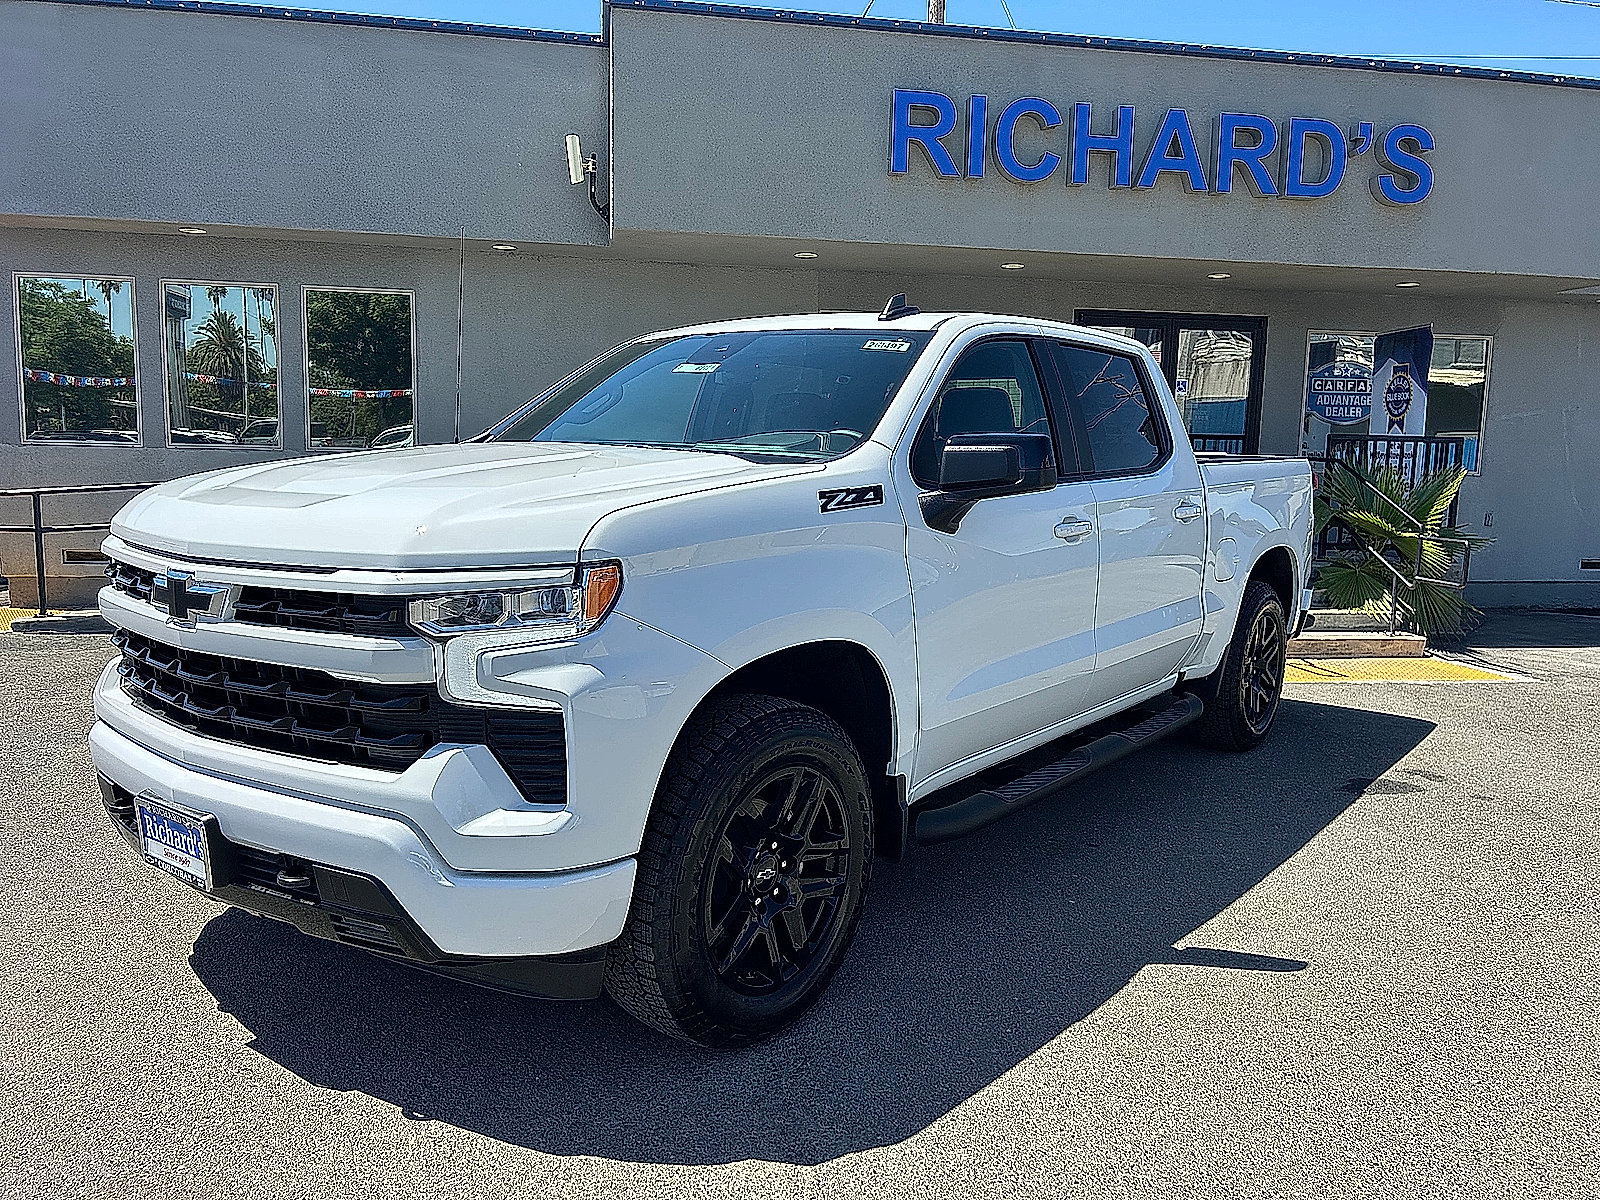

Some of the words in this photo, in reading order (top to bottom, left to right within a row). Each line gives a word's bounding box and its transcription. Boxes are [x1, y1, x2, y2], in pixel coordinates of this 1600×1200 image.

[888, 88, 1436, 205] RICHARD'S
[1316, 394, 1372, 406] ADVANTAGE
[1325, 406, 1363, 418] DEALER
[819, 485, 885, 514] Z71
[143, 813, 205, 861] Richard's
[163, 847, 178, 861] Since
